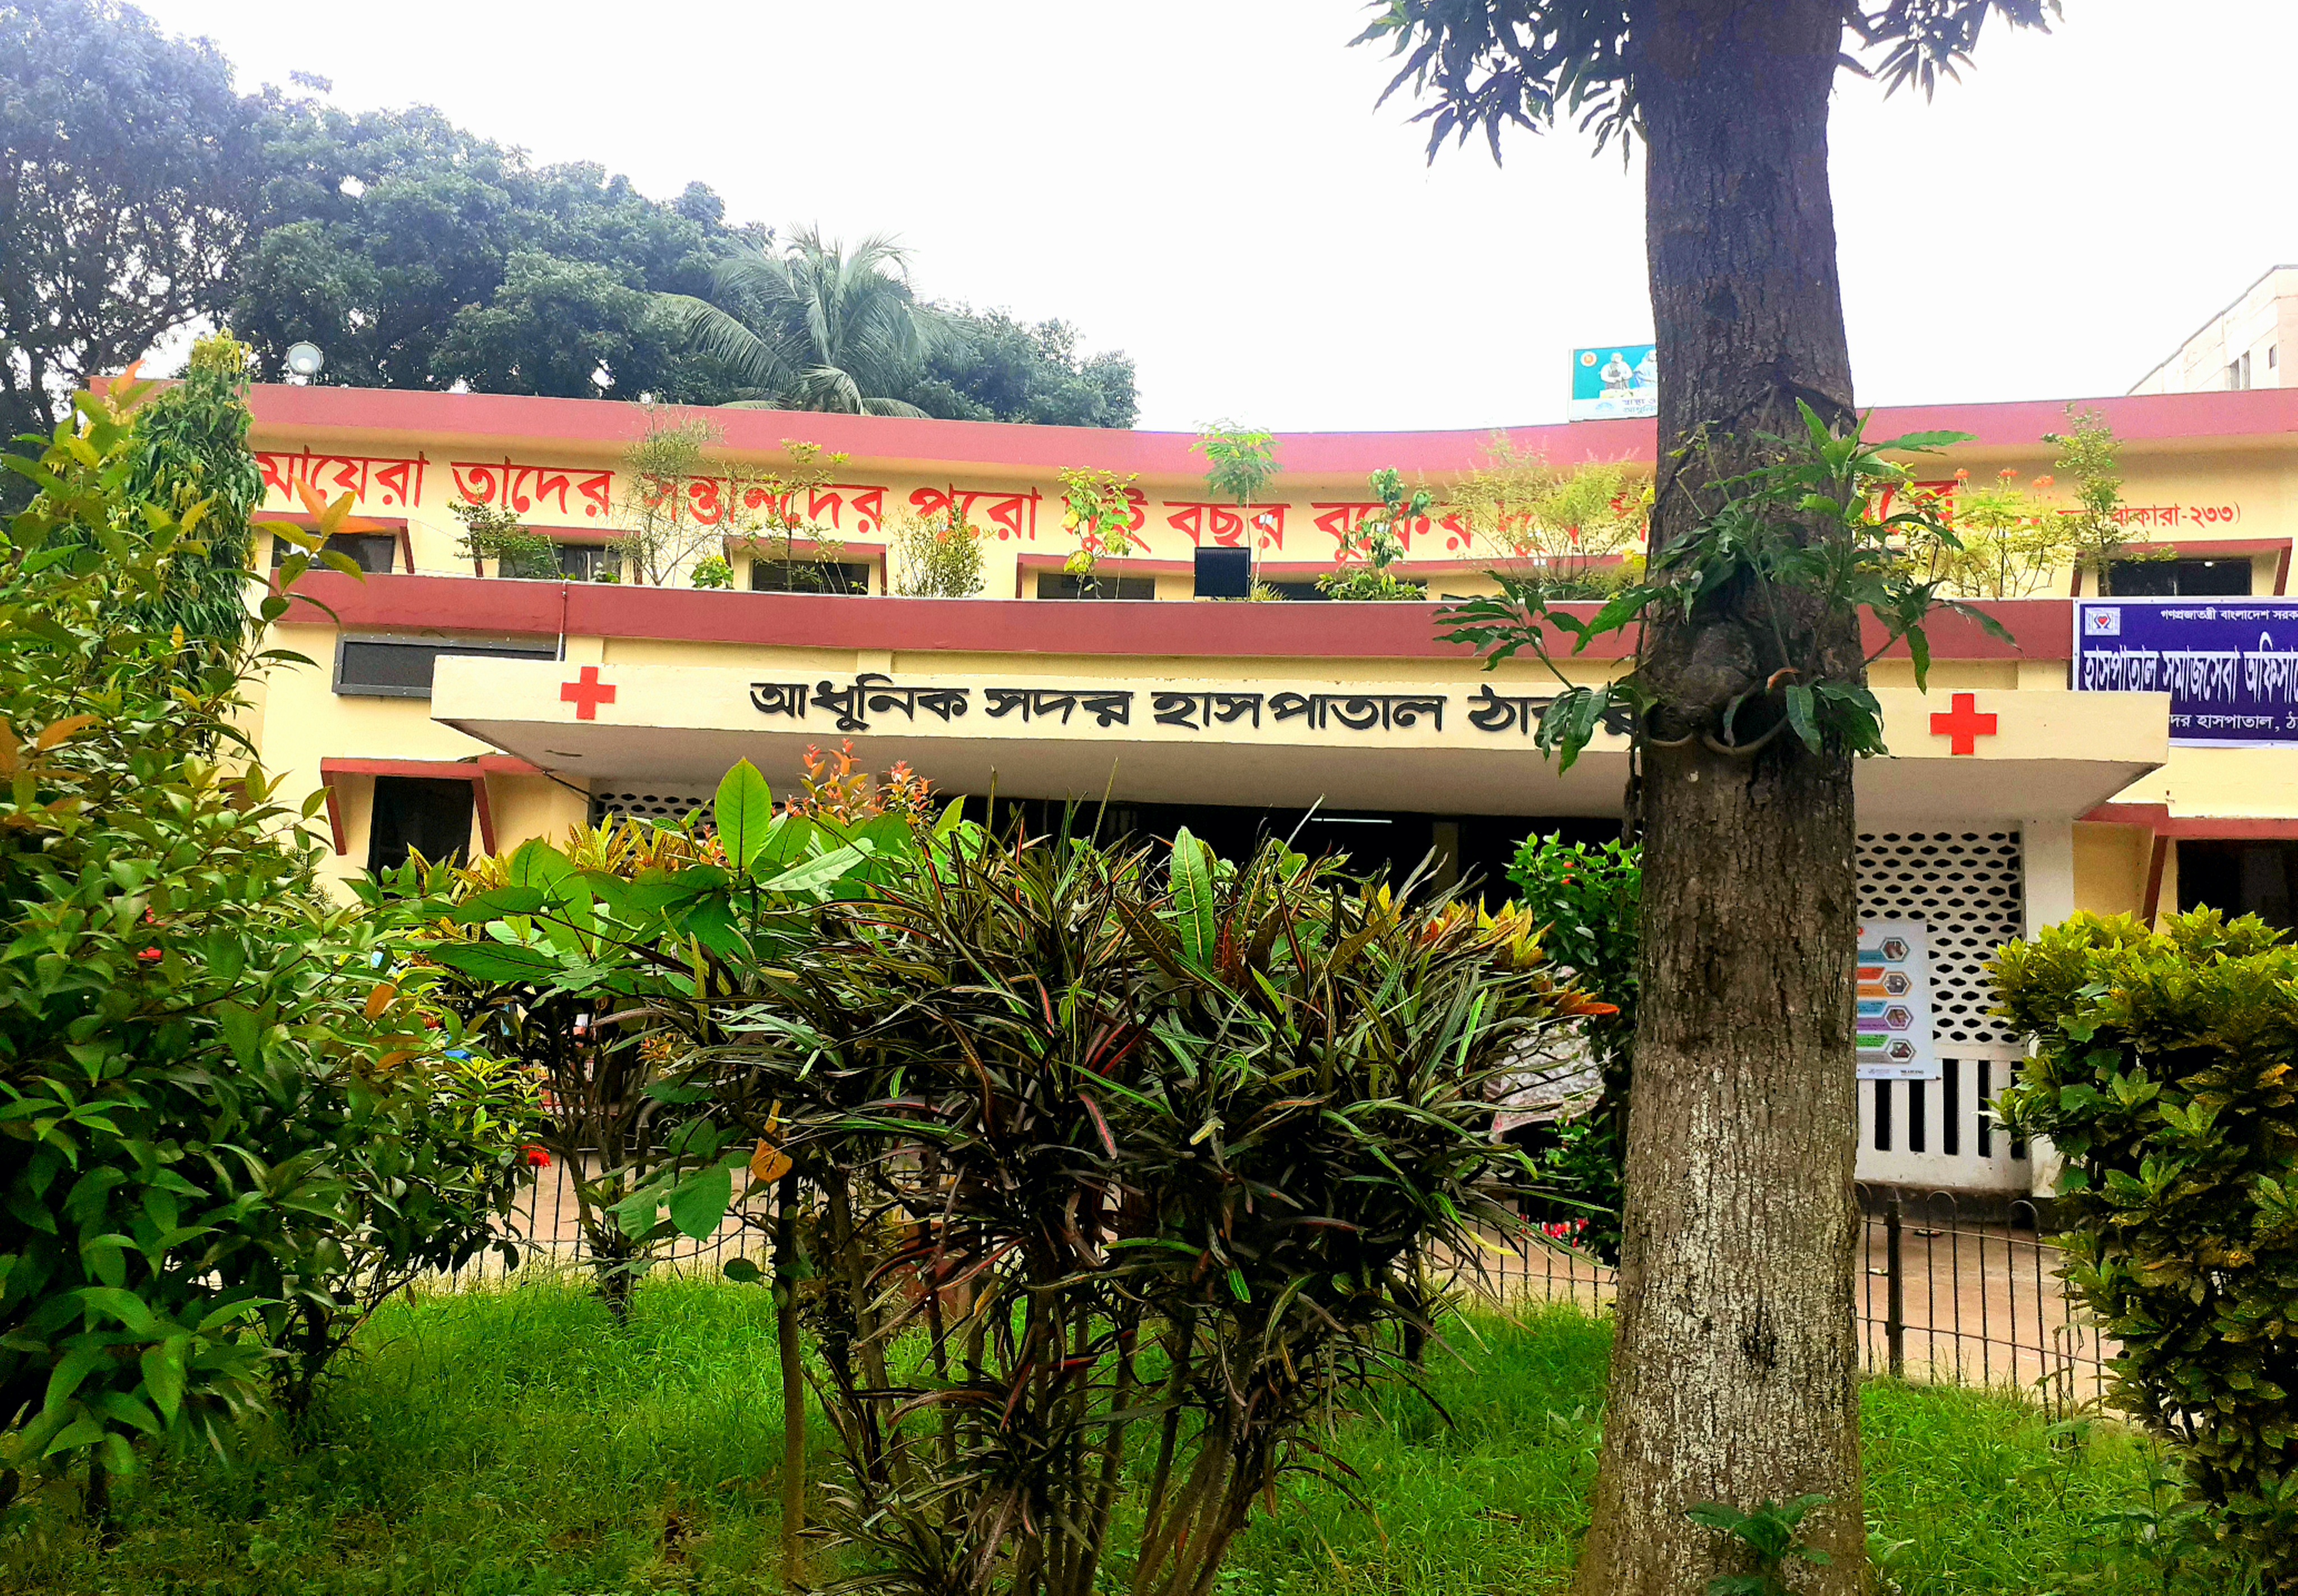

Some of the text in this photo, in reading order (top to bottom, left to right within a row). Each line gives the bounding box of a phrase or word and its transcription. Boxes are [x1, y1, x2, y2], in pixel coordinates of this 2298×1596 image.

[451, 455, 616, 518] তাদের
[1162, 501, 1292, 551] বছর
[2219, 609, 2270, 621] বাংলাদেশ
[750, 673, 971, 732] আধুনিক
[984, 688, 1134, 728] সদর
[1150, 691, 1447, 732] হাসপাতাল
[2162, 645, 2241, 705] সমাজসেবা
